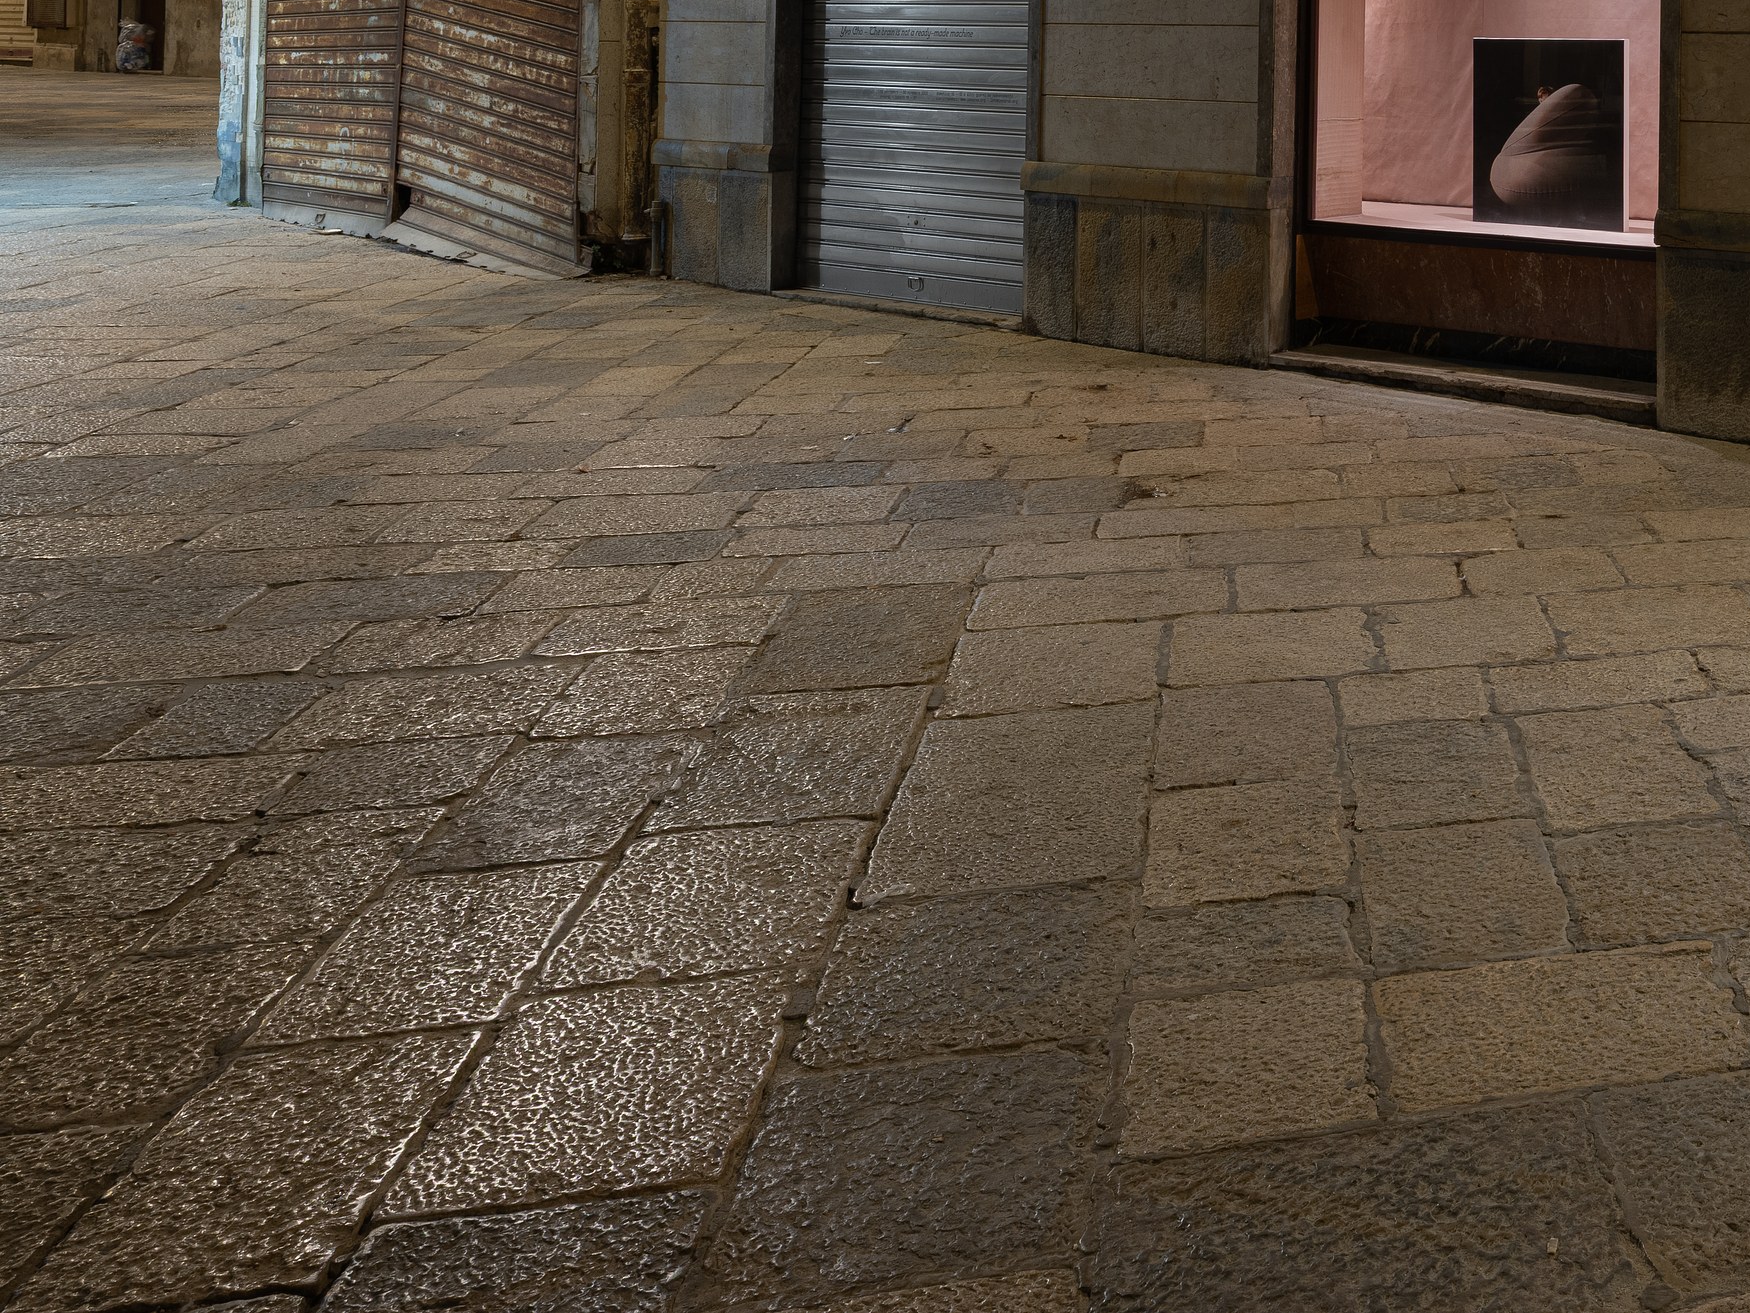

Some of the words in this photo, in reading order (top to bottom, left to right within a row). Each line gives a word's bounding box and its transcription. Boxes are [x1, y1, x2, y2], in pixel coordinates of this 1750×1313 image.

[869, 26, 881, 36] The
[900, 28, 911, 37] not
[915, 28, 949, 40] ready-made
[949, 28, 974, 38] machine
